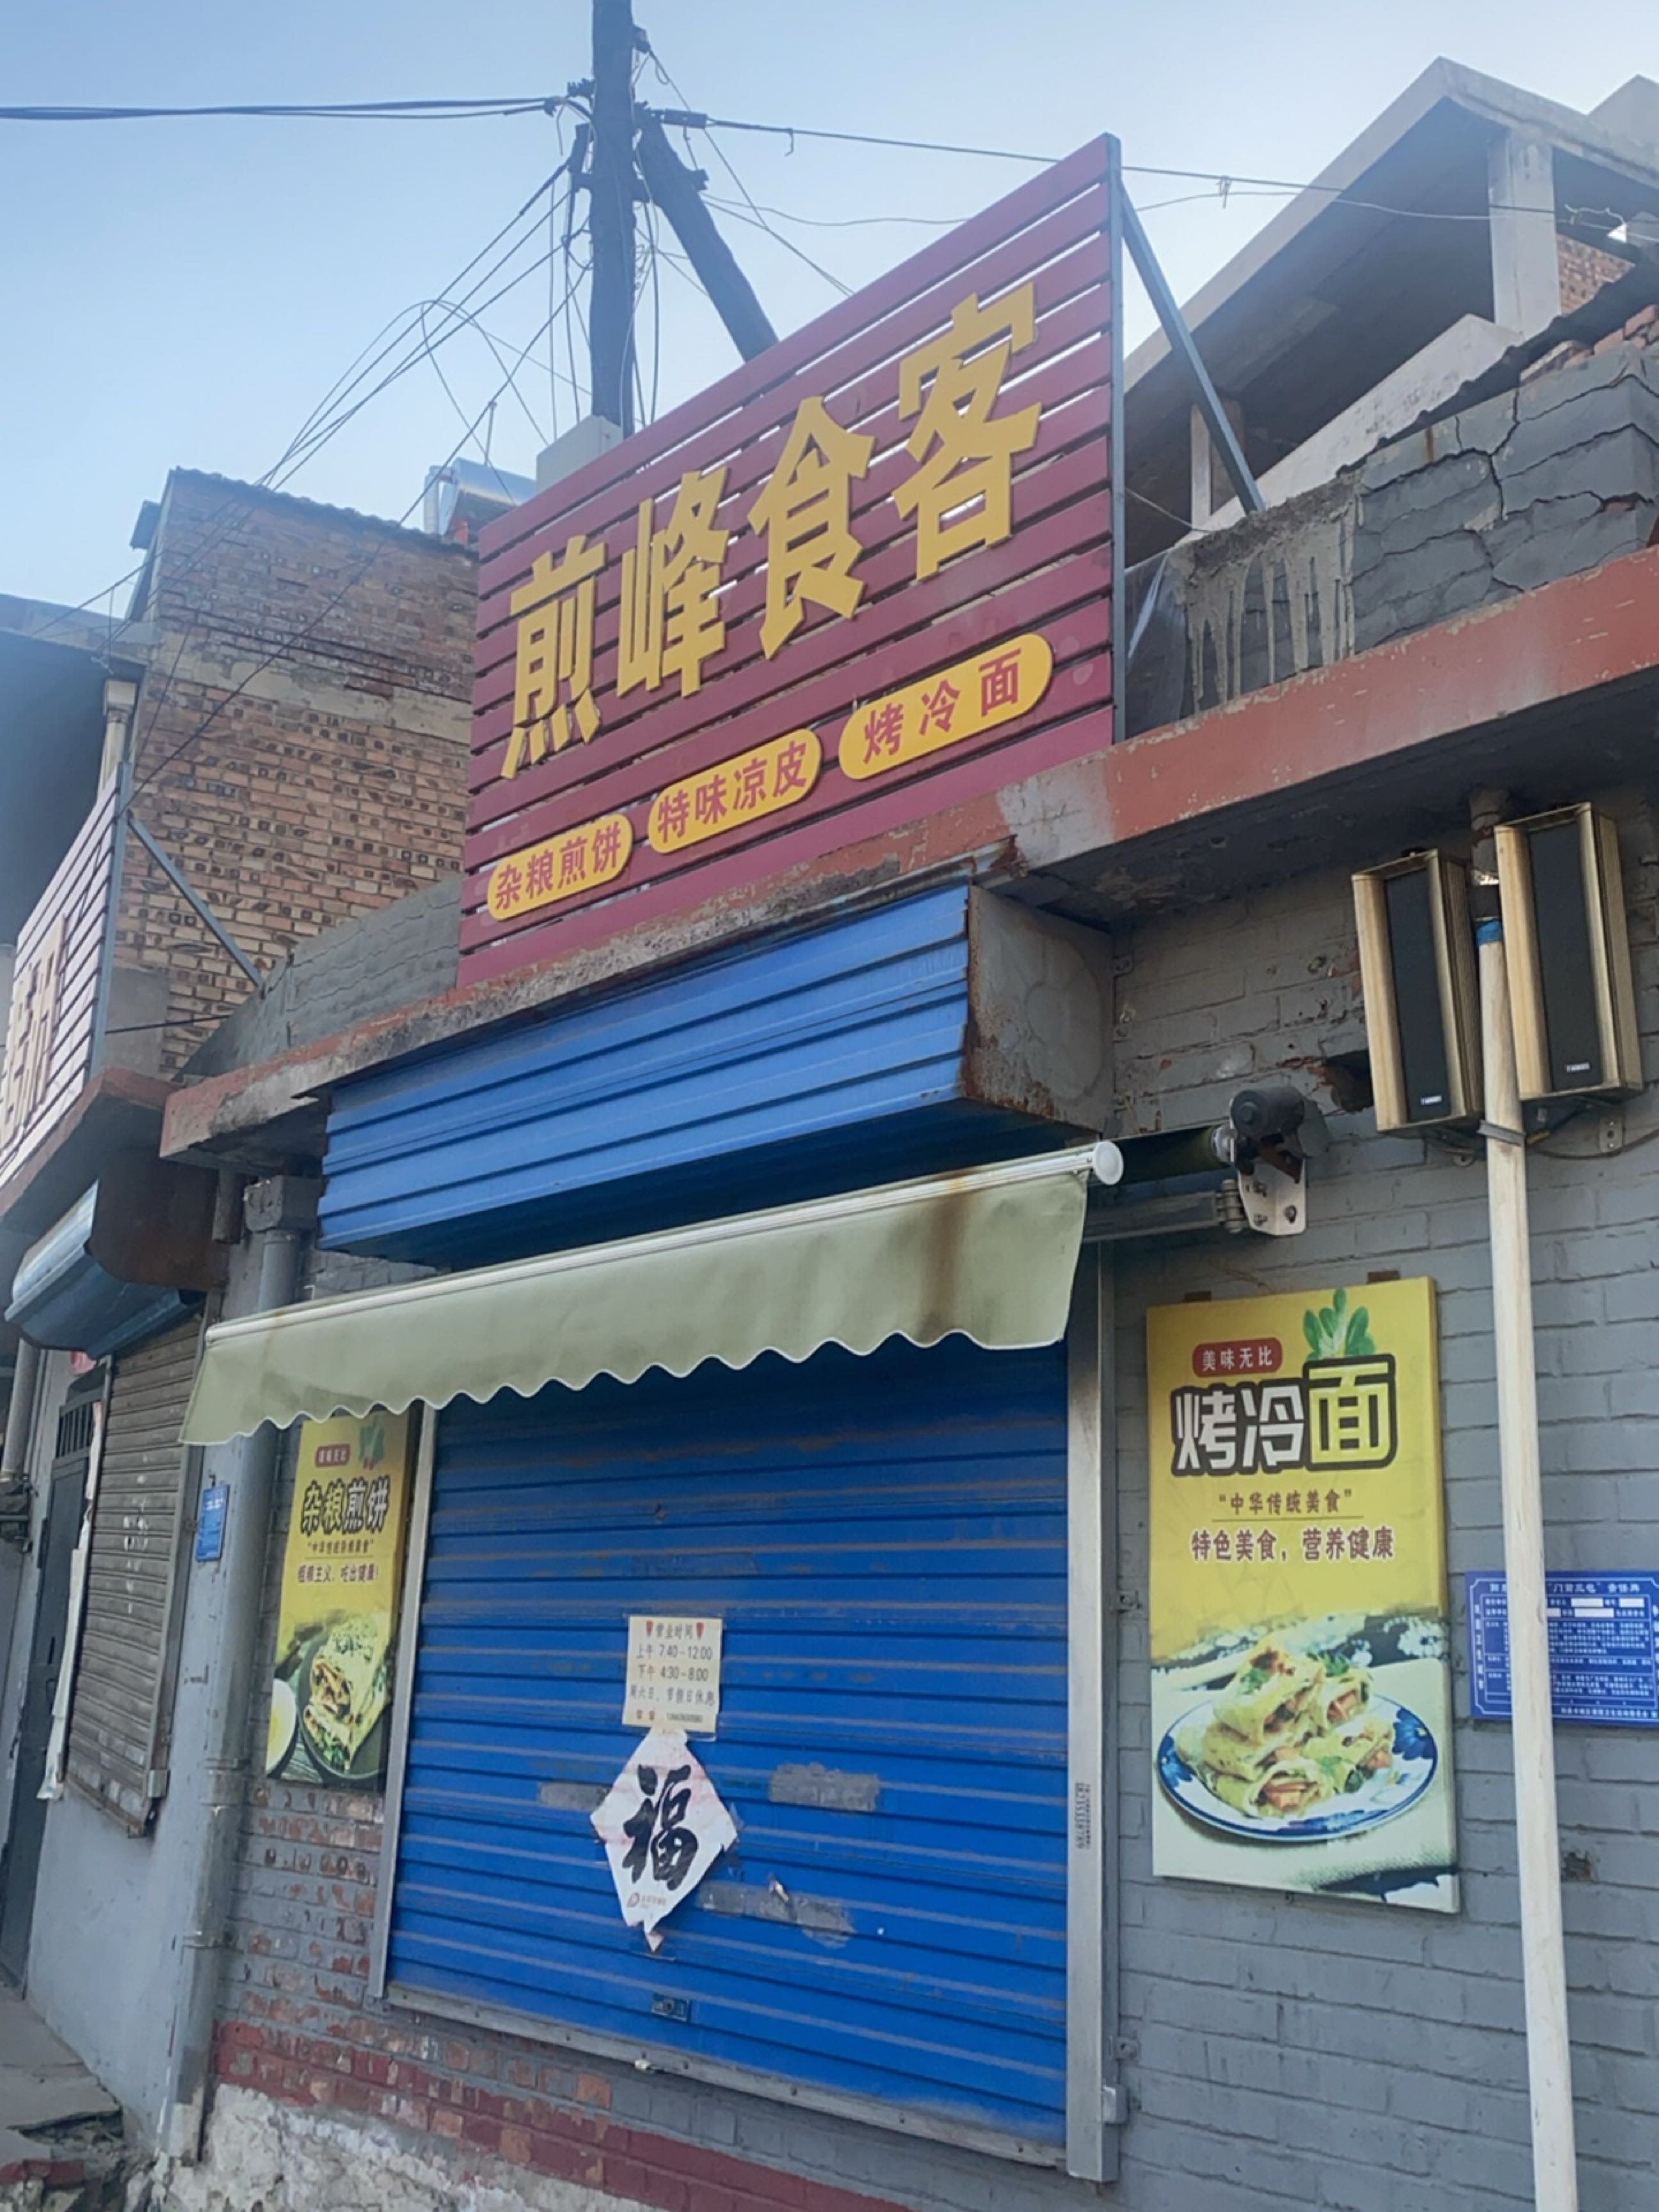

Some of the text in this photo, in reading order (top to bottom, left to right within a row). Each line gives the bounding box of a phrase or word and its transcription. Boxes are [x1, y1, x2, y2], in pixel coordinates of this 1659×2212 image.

[502, 281, 1042, 778] 煎峰食客
[864, 648, 1022, 764] 烤冷面
[659, 740, 808, 844] 特味凉皮
[495, 821, 621, 910] 杂粮煎饼
[1202, 1346, 1273, 1372] 美味无比
[1173, 1354, 1397, 1475] 烤冷面
[301, 1475, 390, 1536] 杂粮煎饼
[636, 1643, 653, 1660] 上午
[638, 1664, 655, 1681] 下午
[622, 1764, 698, 1891] 福
